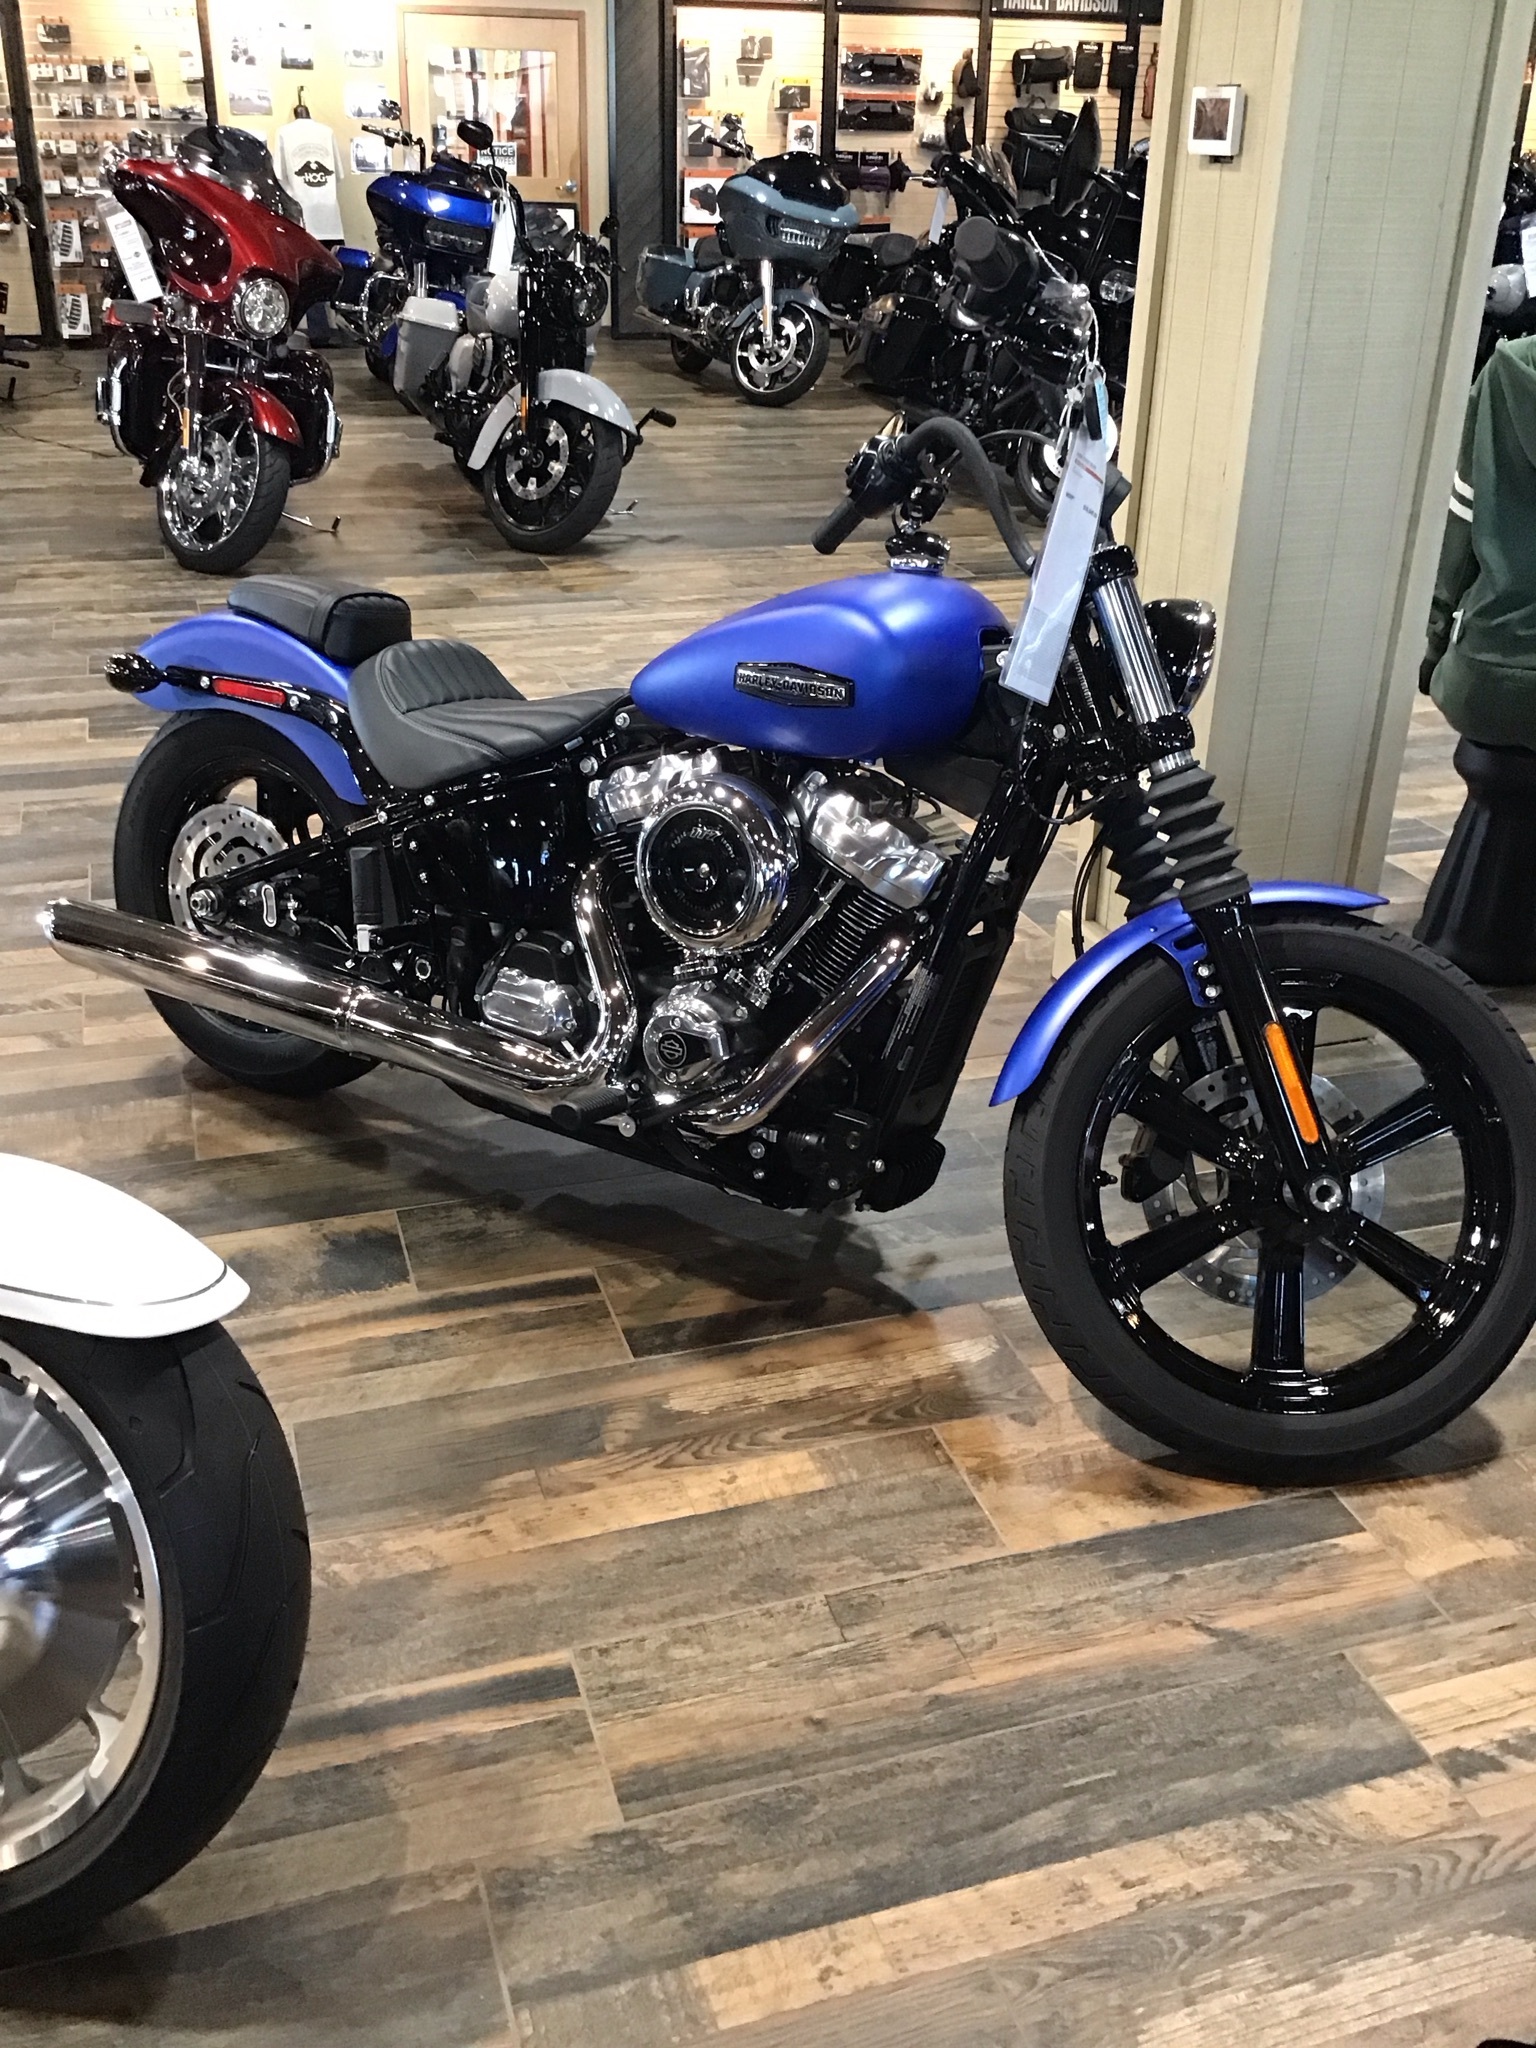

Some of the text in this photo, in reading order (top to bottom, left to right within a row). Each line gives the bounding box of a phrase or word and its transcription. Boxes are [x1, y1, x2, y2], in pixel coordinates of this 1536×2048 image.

[1003, 0, 1119, 13] DAVIDSON
[480, 146, 514, 156] NOTICE
[736, 670, 846, 701] HARLEY-DAVIDSON
